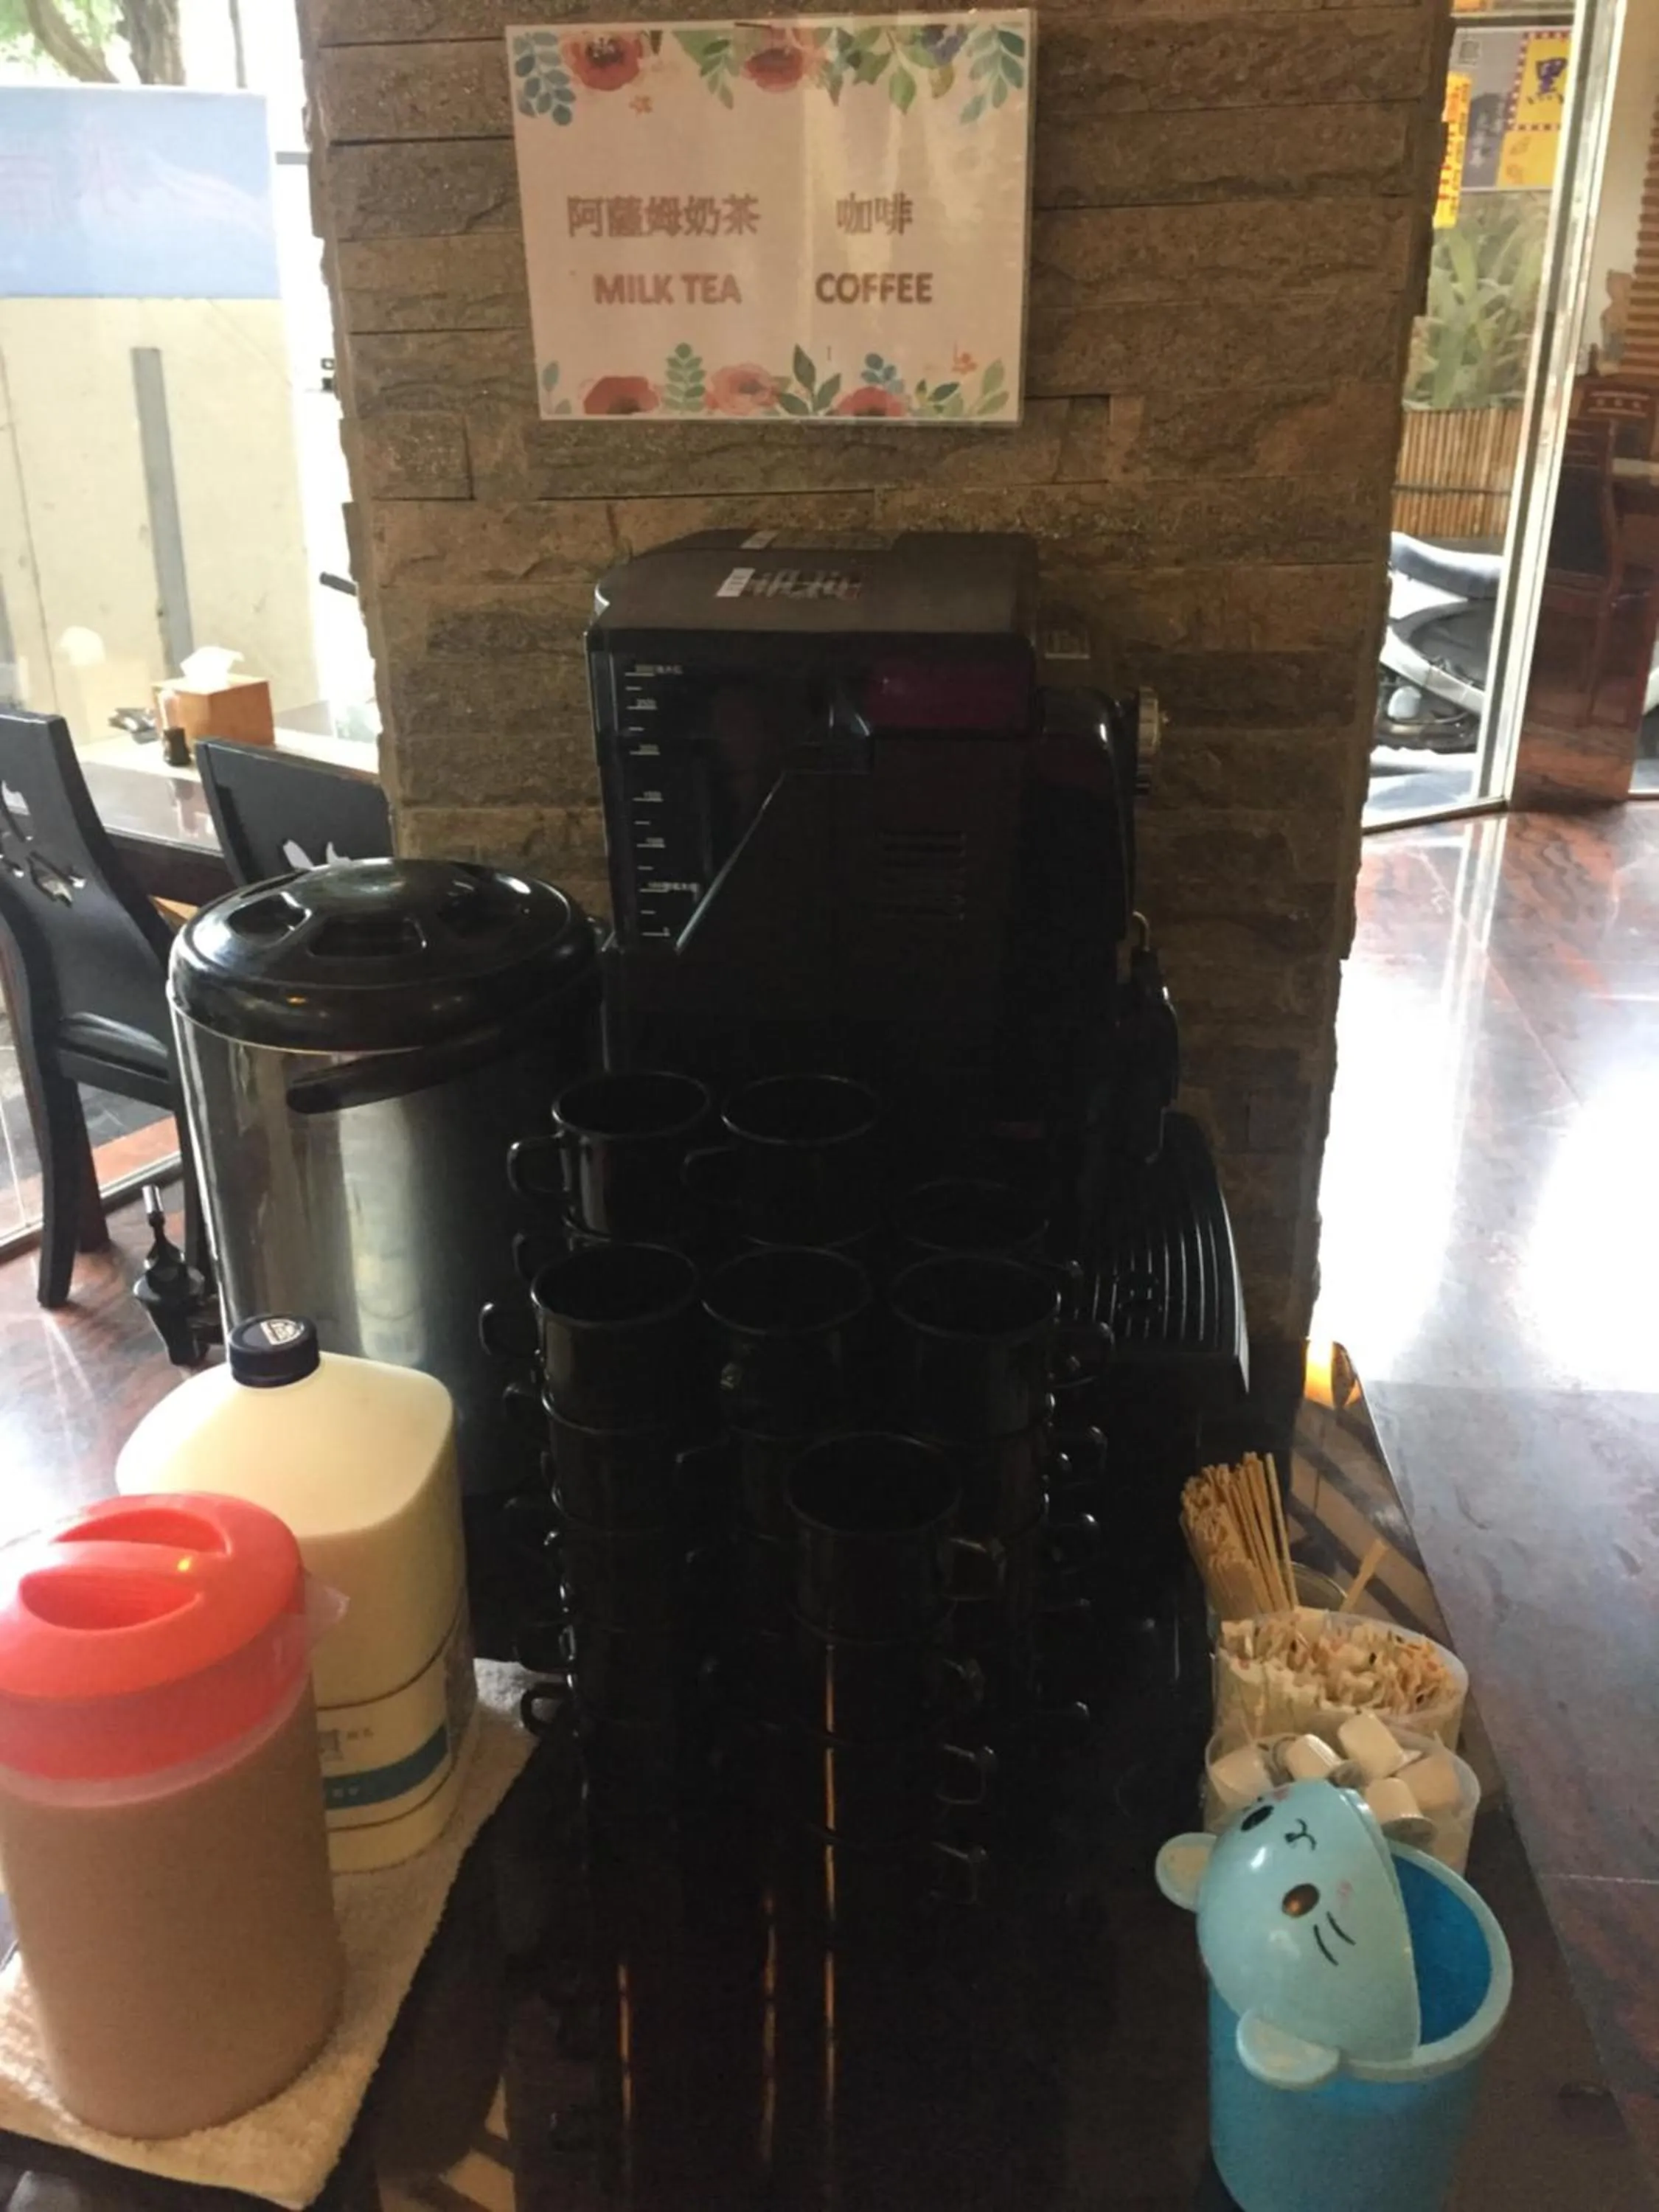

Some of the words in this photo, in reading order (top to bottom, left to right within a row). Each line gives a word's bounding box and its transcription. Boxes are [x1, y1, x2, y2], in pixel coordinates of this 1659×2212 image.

[567, 194, 760, 237] 阿薩姆奶茶
[836, 192, 914, 235] 咖啡
[594, 274, 675, 305] MILK
[681, 273, 742, 305] TEA
[815, 271, 933, 305] COFFEE
